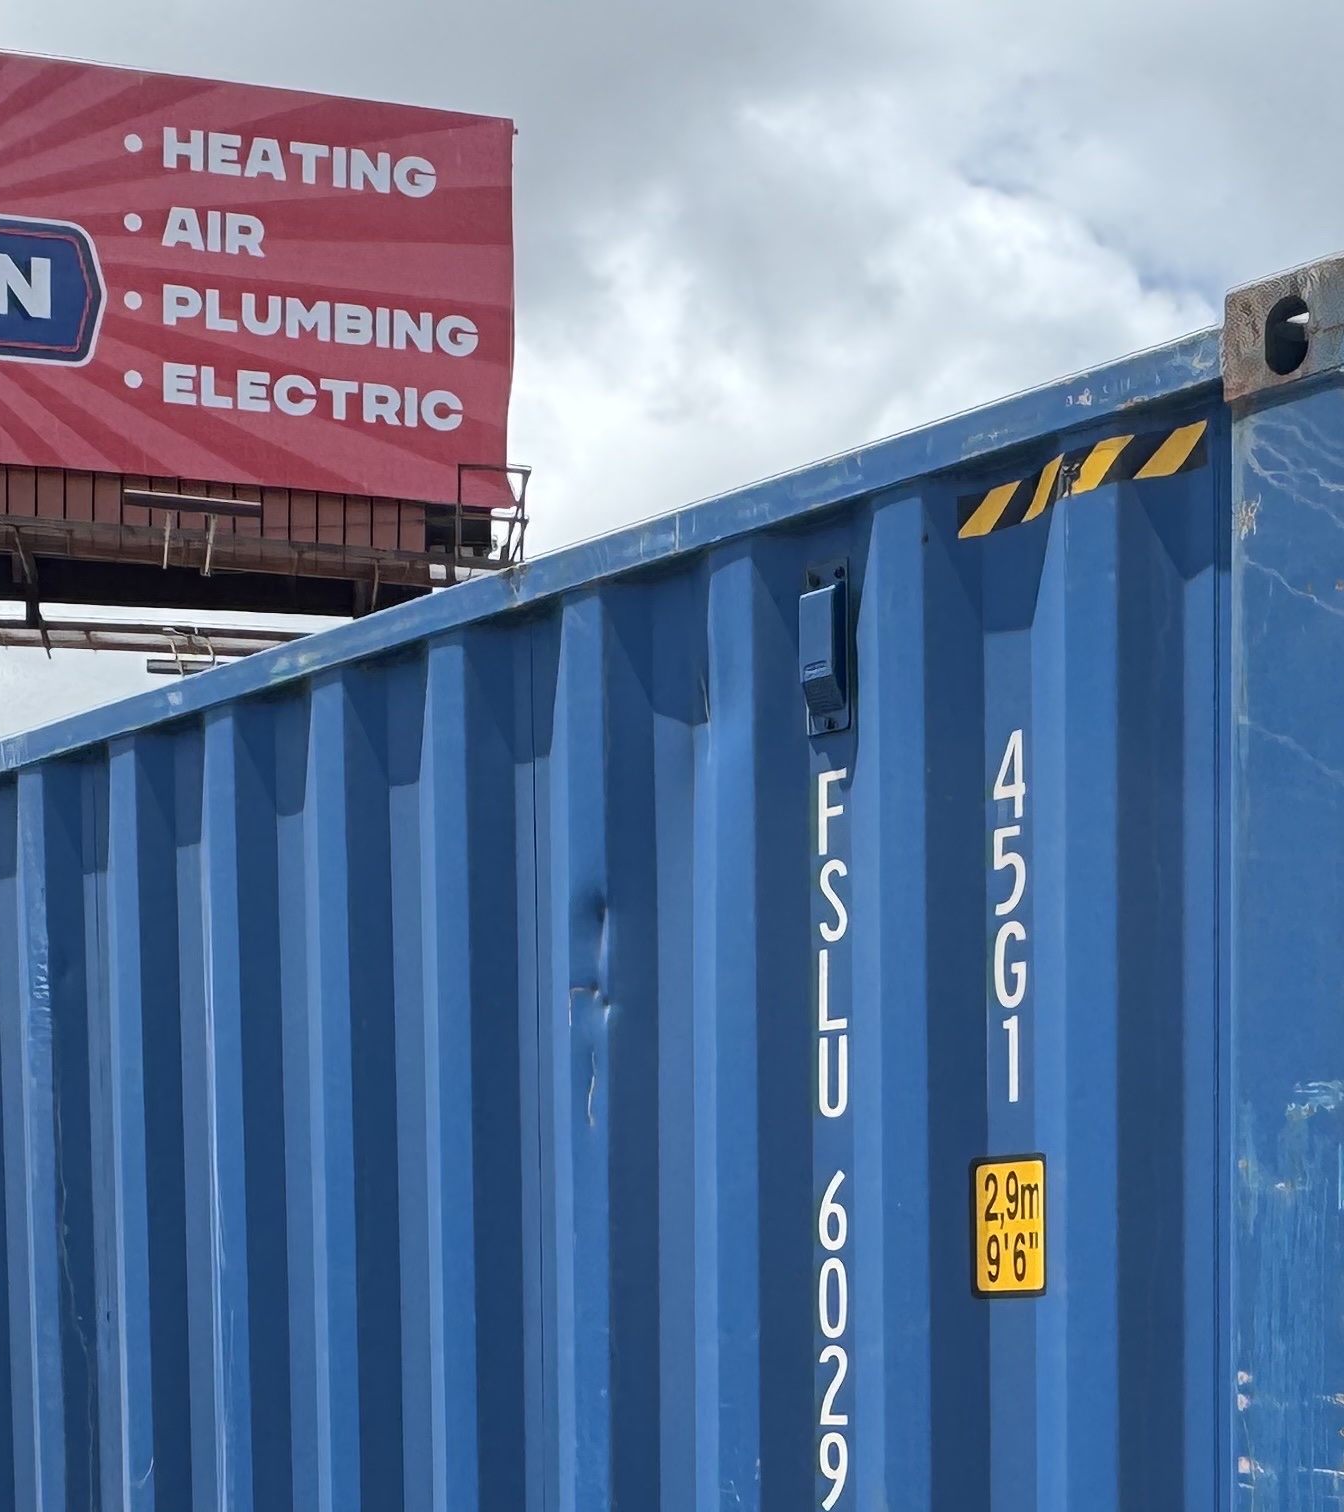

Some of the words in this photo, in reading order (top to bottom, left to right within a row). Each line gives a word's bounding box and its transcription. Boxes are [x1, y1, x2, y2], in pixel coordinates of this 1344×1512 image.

[163, 127, 436, 197] HEATING
[161, 207, 265, 257] AIR
[163, 284, 479, 357] PLUMBING
[163, 362, 464, 431] ELECTRIC
[818, 767, 848, 1118] FSLU
[993, 729, 1027, 1103] 45G1
